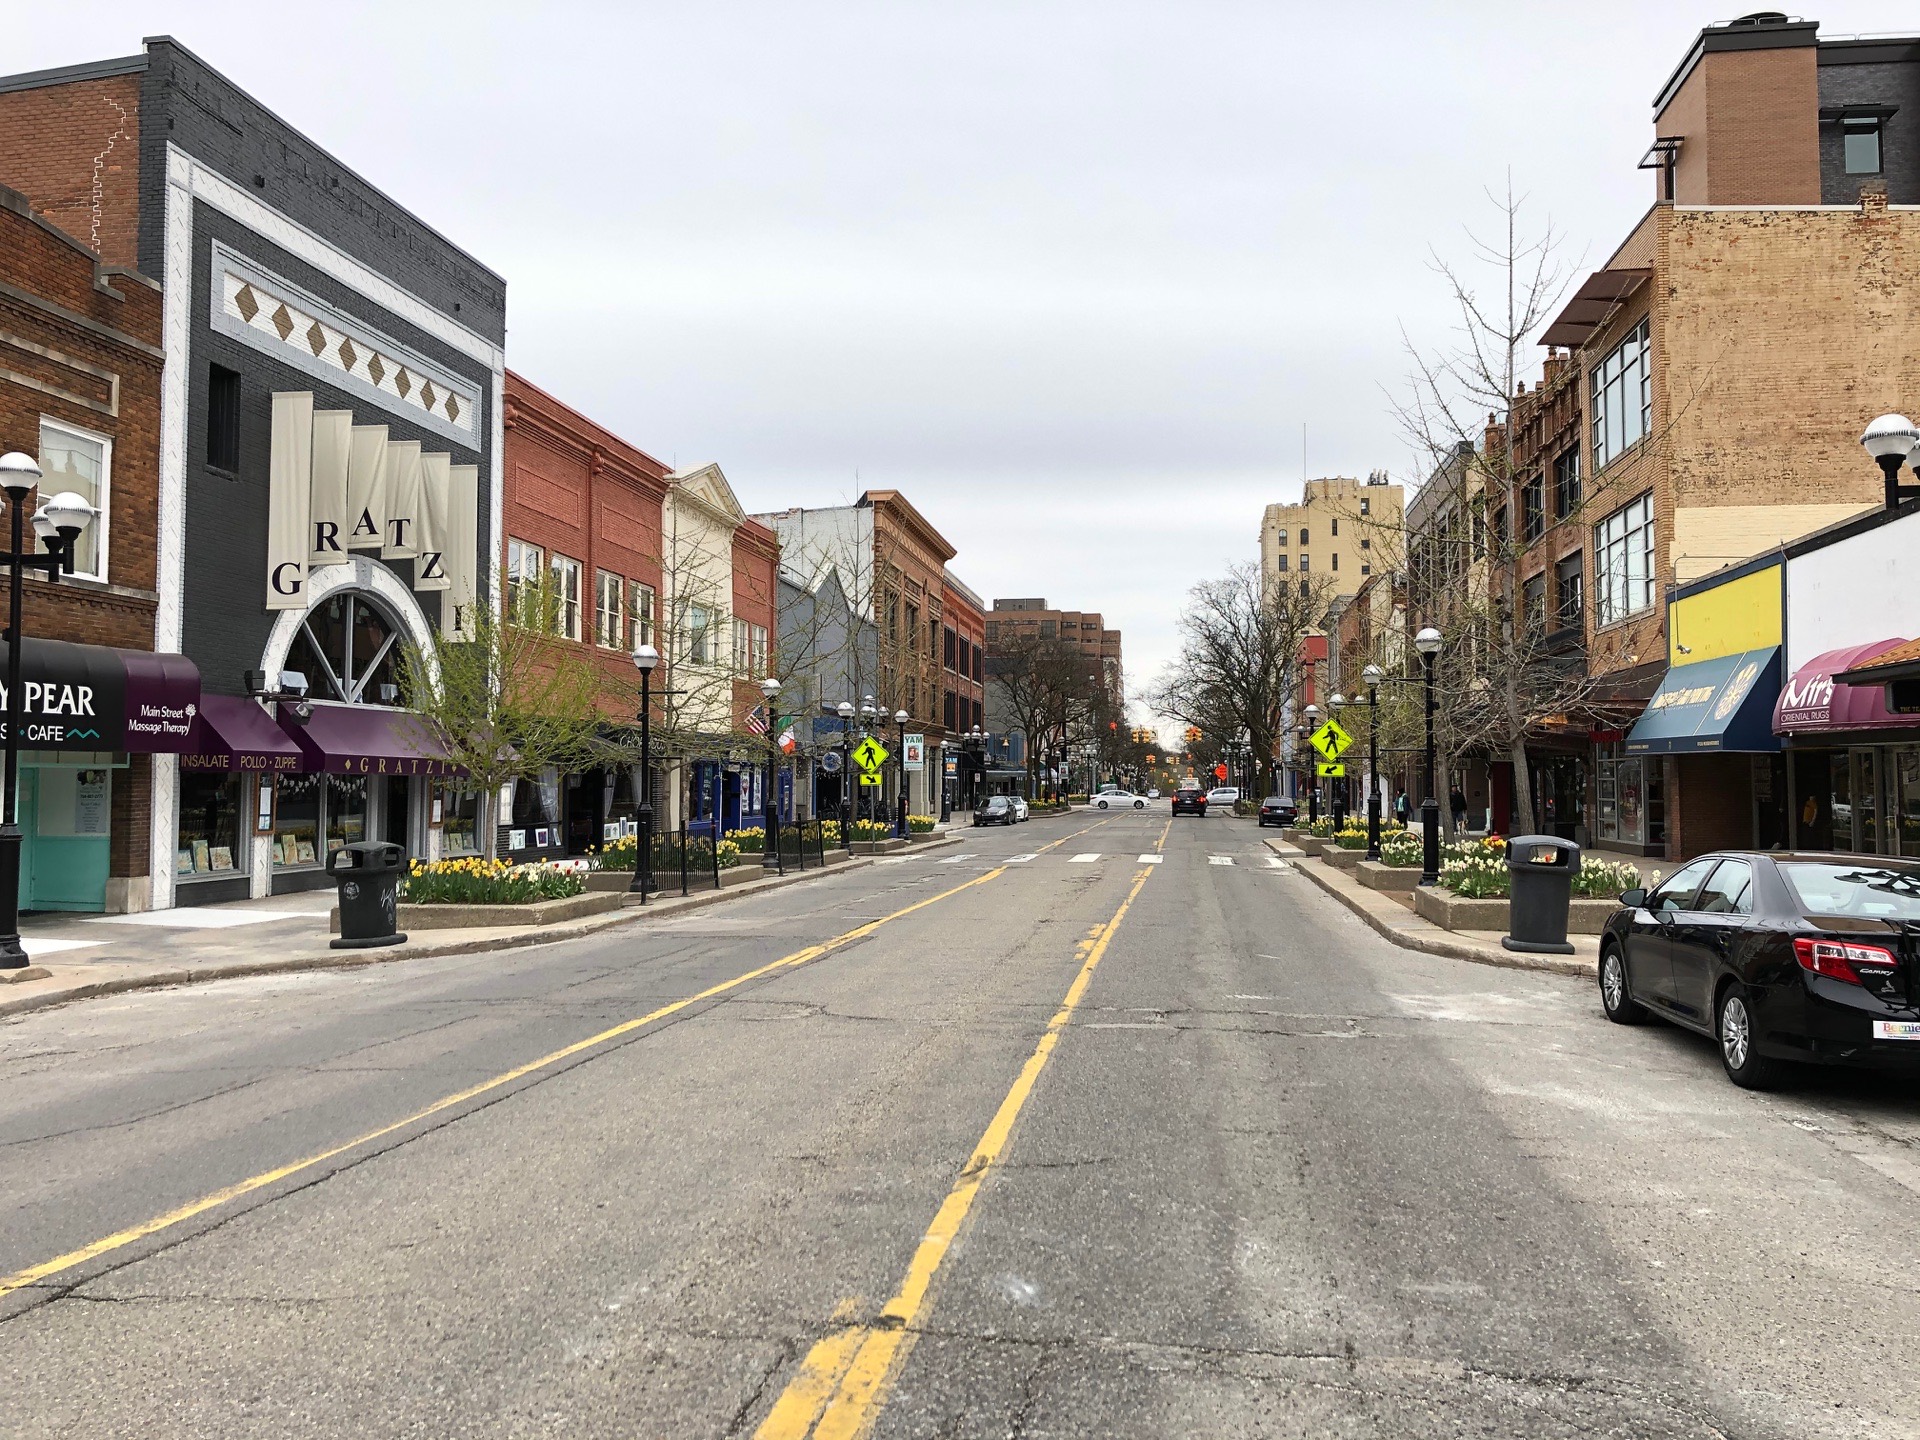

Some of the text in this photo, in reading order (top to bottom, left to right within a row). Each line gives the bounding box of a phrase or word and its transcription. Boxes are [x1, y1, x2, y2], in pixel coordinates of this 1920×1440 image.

[23, 681, 96, 716] PEAR
[141, 704, 184, 719] Main Street
[1781, 710, 1830, 723] ORIENTAL RUGS
[27, 724, 64, 741] CAFE
[128, 718, 189, 736] Massage Therapy
[180, 754, 297, 769] INSALATE POLLO ZUPPE
[360, 757, 446, 774] GRATZI
[1883, 1022, 1920, 1033] Bernie
